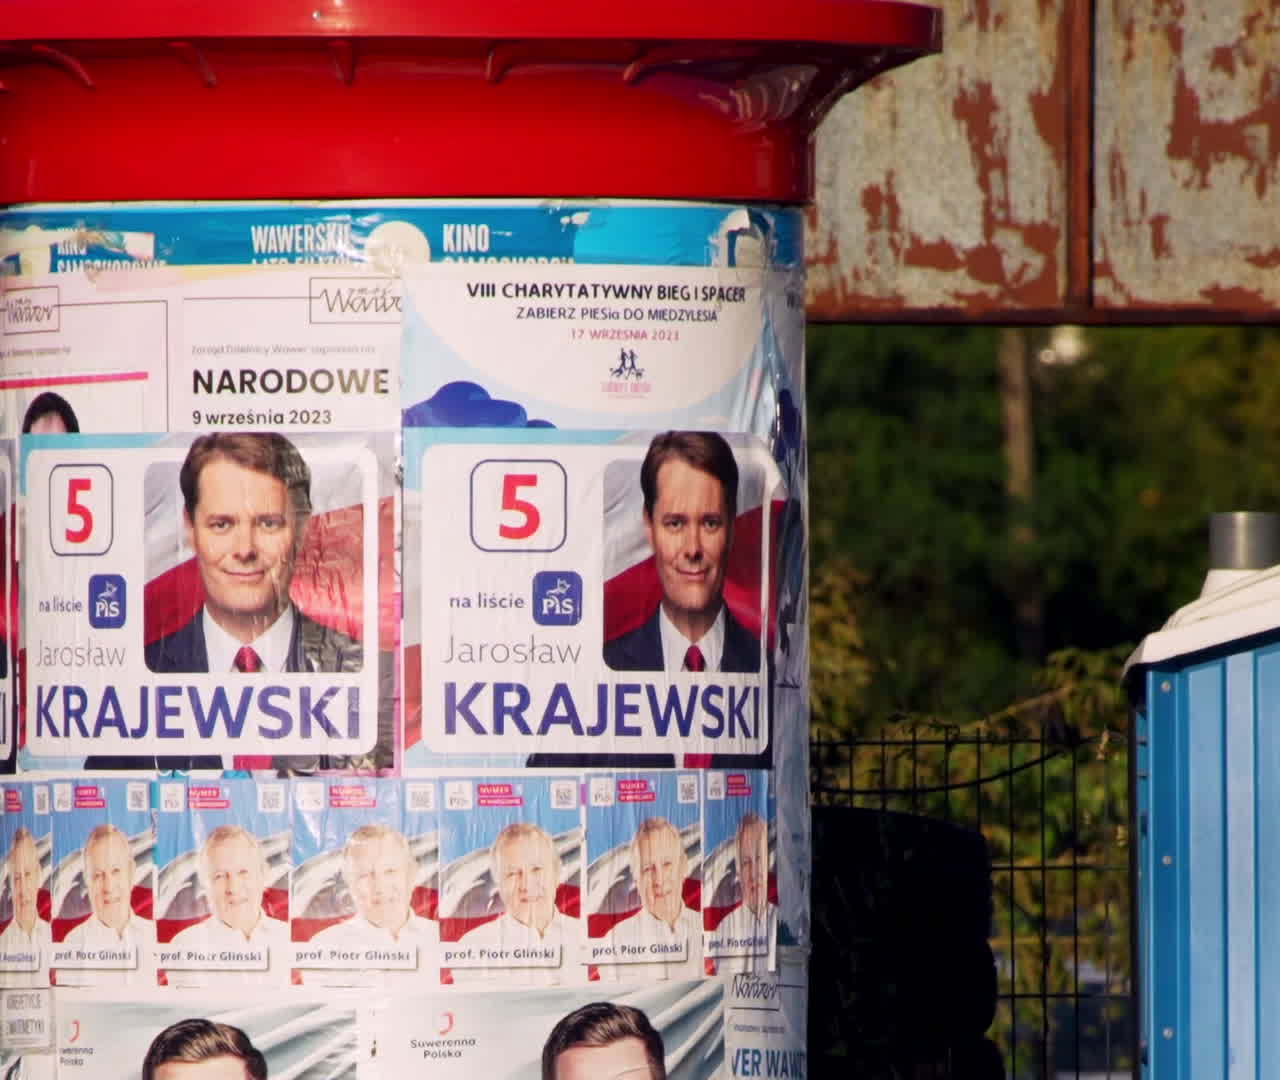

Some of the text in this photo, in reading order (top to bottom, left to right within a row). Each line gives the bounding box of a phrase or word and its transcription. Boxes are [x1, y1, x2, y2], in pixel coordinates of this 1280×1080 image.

[443, 224, 489, 252] KINO
[467, 283, 496, 298] VIII
[502, 283, 652, 300] CHARYTATYWNY
[657, 285, 690, 301] BIEG
[702, 286, 746, 302] SPACER
[516, 307, 576, 320] ZABIERZ
[623, 308, 644, 321] DO
[571, 329, 585, 341] 17
[193, 369, 389, 394] NARODOWE
[193, 409, 332, 425] 9 września 2023
[65, 479, 93, 543] 5
[499, 474, 540, 539] 5
[39, 601, 51, 612] na
[53, 596, 82, 612] liście
[449, 597, 473, 609] na
[478, 591, 524, 609] liście
[37, 637, 125, 667] Jarosław
[444, 635, 582, 664] Jarosław
[36, 685, 360, 740] KRAJEWSKI
[444, 682, 759, 739] KRAJEWSKI
[411, 1038, 476, 1048] Suwerenna
[424, 1050, 462, 1059] Polska
